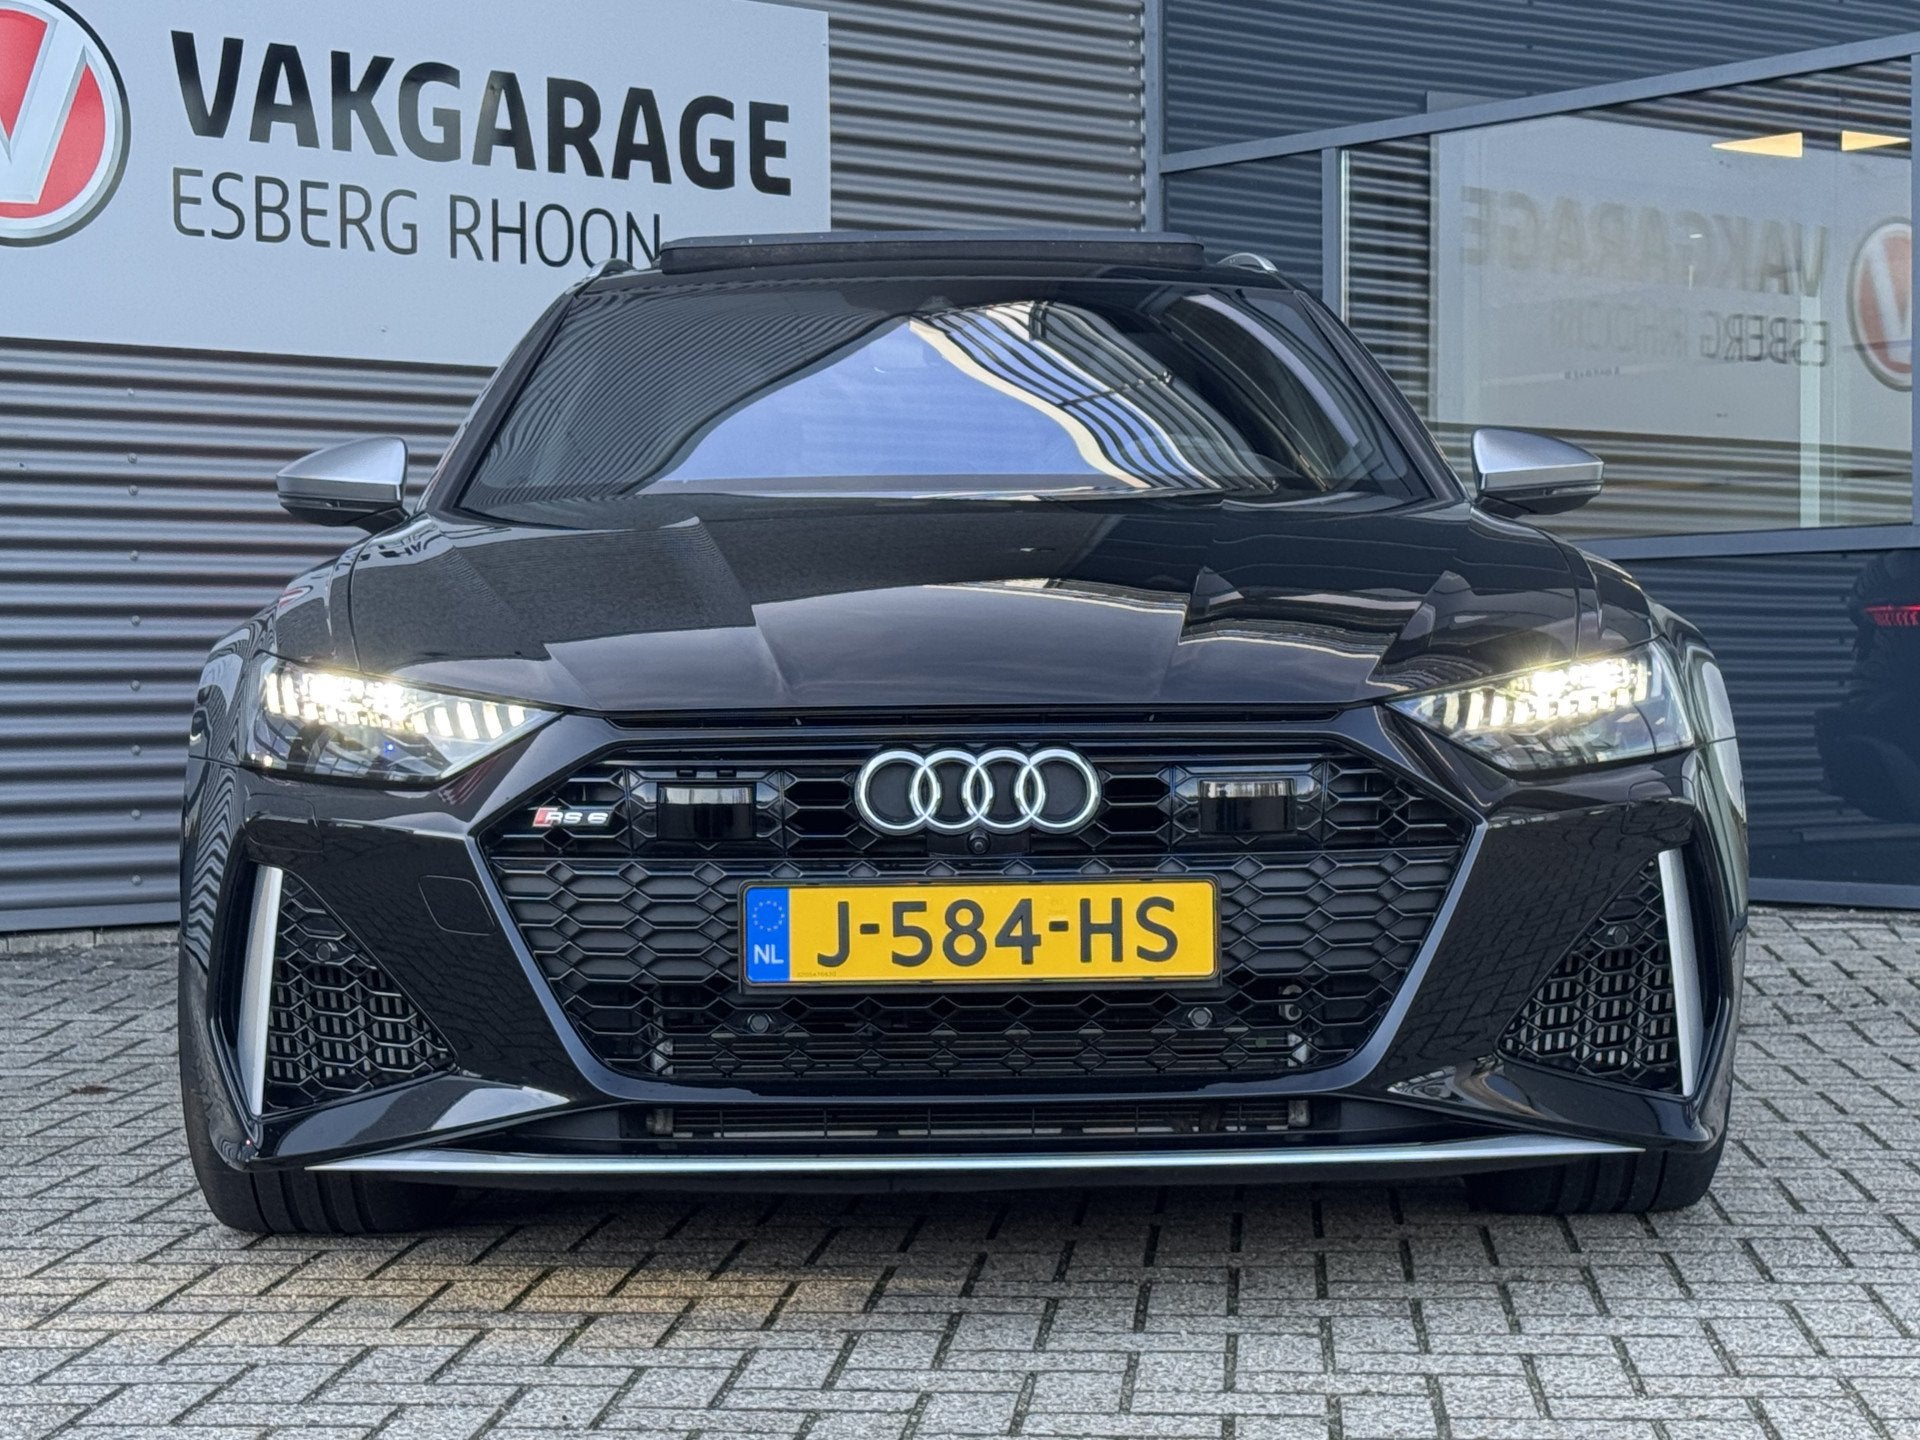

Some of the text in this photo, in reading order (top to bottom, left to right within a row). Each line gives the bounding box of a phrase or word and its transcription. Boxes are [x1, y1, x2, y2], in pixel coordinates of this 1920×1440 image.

[171, 30, 792, 197] VAKGARAGE
[172, 167, 660, 269] ESBERG RHOON
[541, 810, 608, 825] RS 6
[754, 944, 784, 965] NL
[817, 896, 1179, 968] J-584-HS
